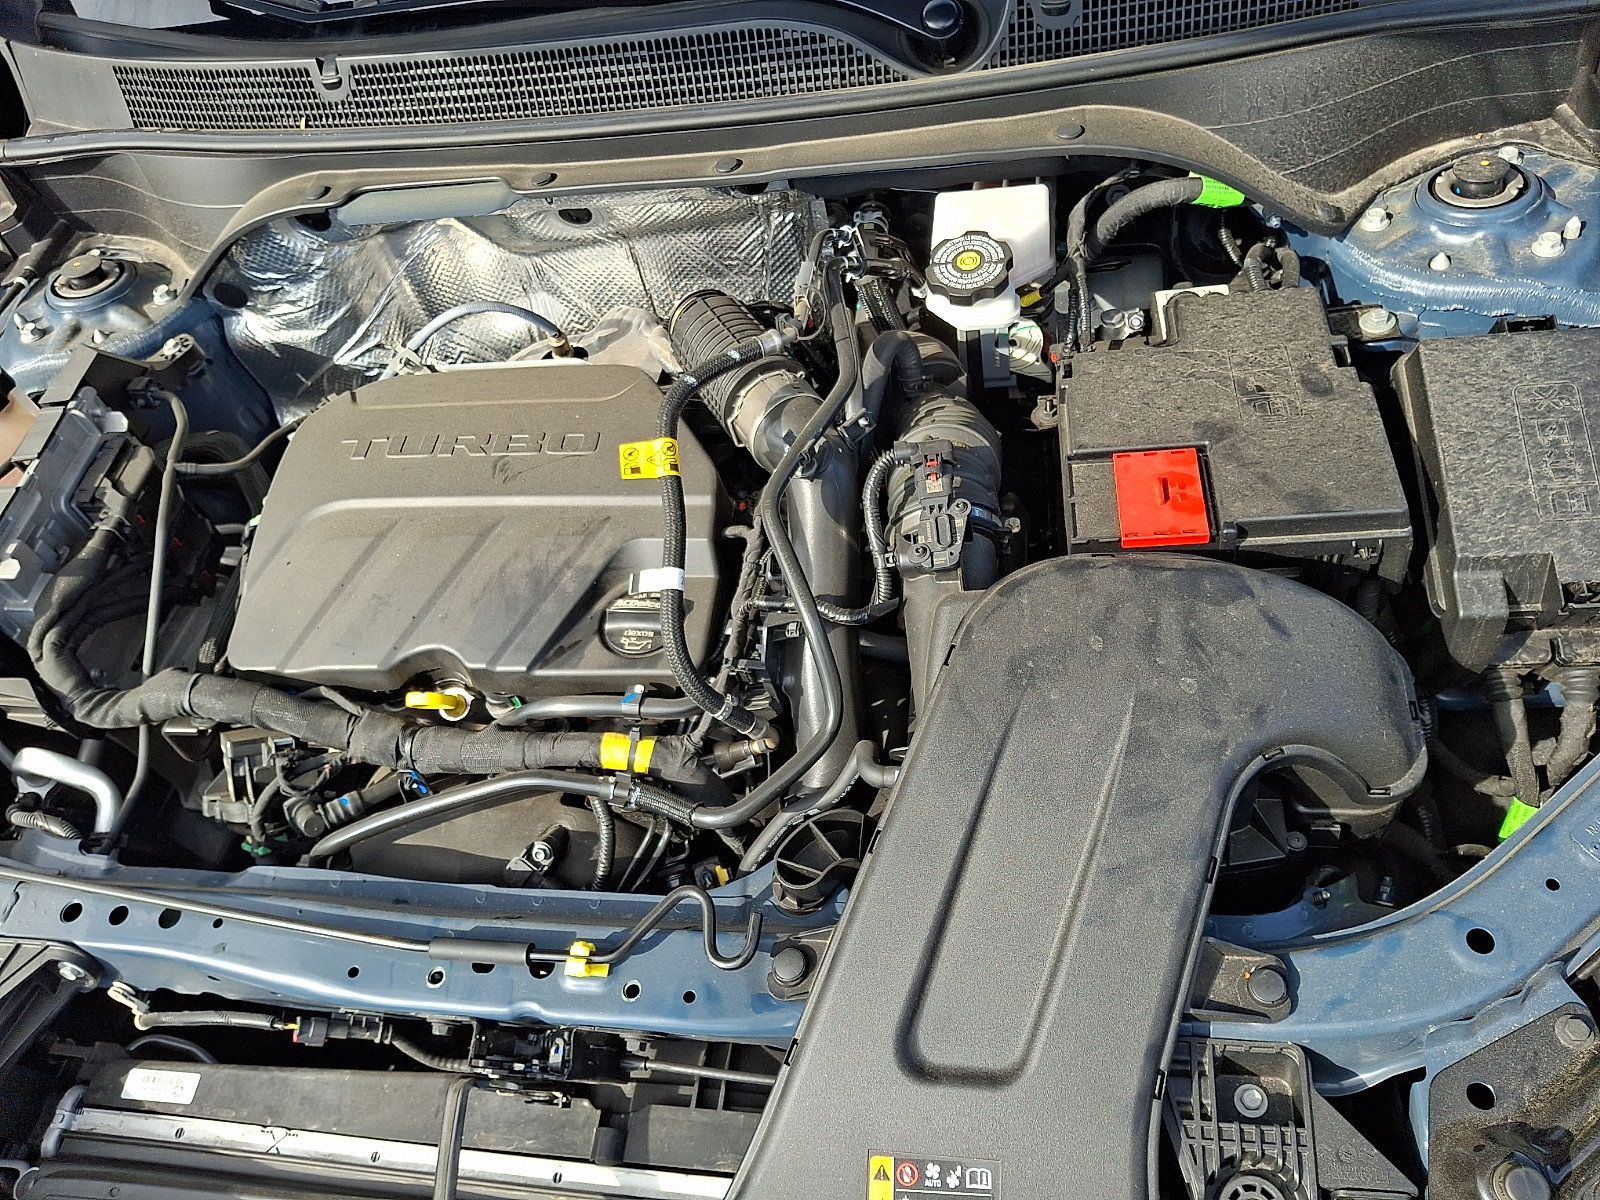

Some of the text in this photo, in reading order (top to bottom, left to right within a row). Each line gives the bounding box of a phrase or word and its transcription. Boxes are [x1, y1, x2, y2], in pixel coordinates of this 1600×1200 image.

[341, 432, 602, 460] TURBO
[623, 629, 654, 637] dexos
[924, 1178, 942, 1188] AUTO
